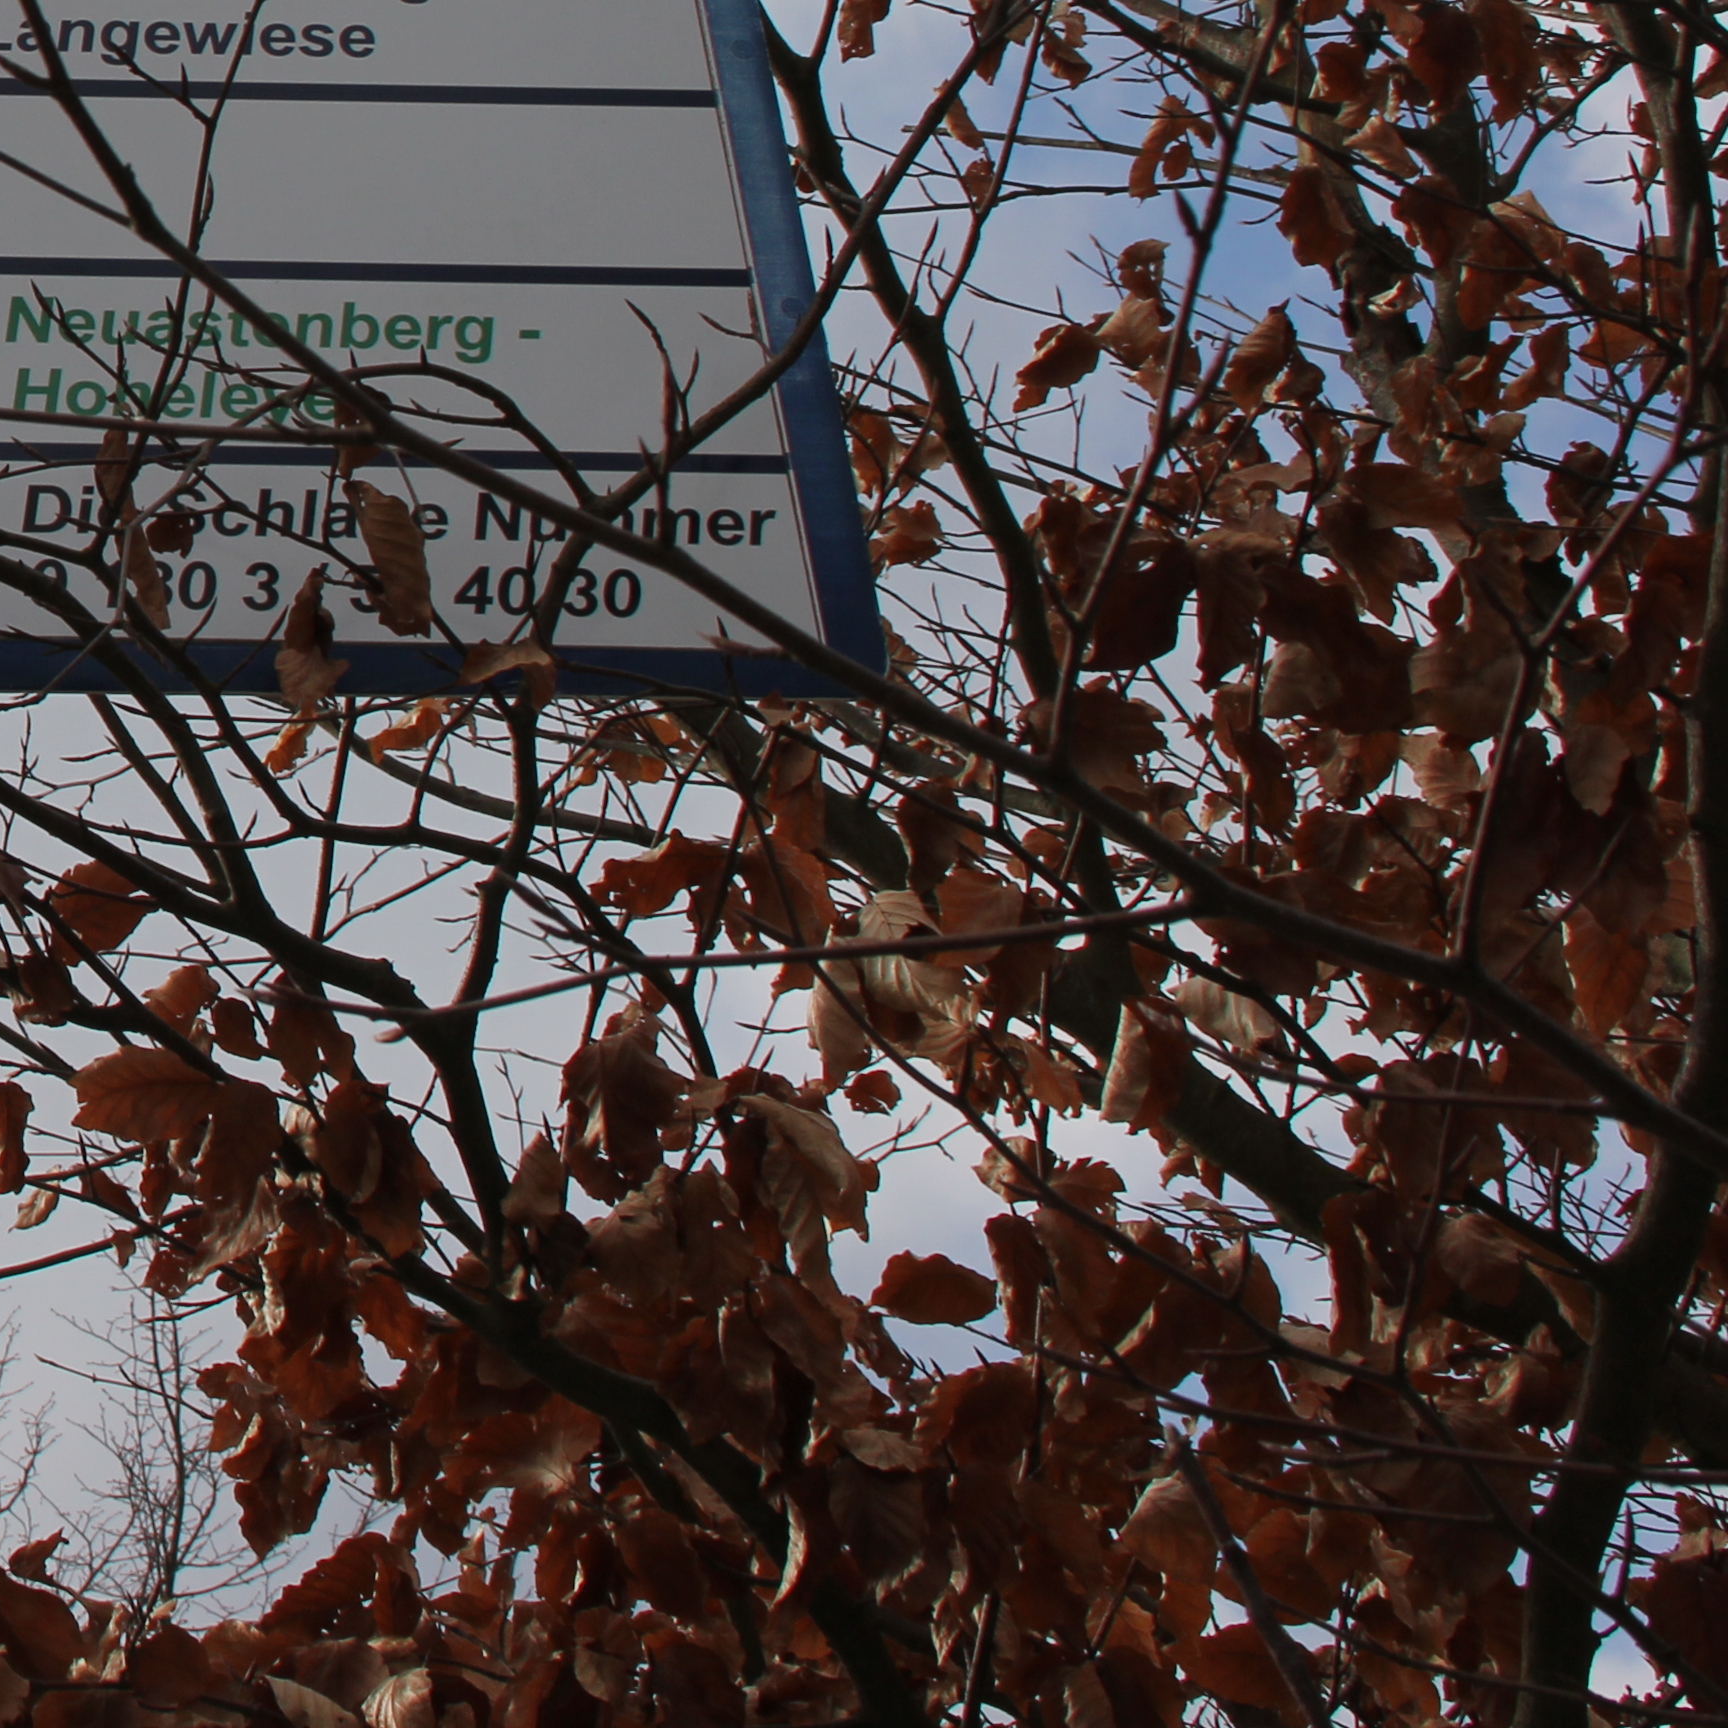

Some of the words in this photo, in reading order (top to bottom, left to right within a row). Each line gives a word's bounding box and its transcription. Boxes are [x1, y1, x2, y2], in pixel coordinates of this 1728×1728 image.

[5, 296, 493, 364] Neuastenberg
[22, 485, 134, 534] Di
[164, 486, 448, 539] Schlae
